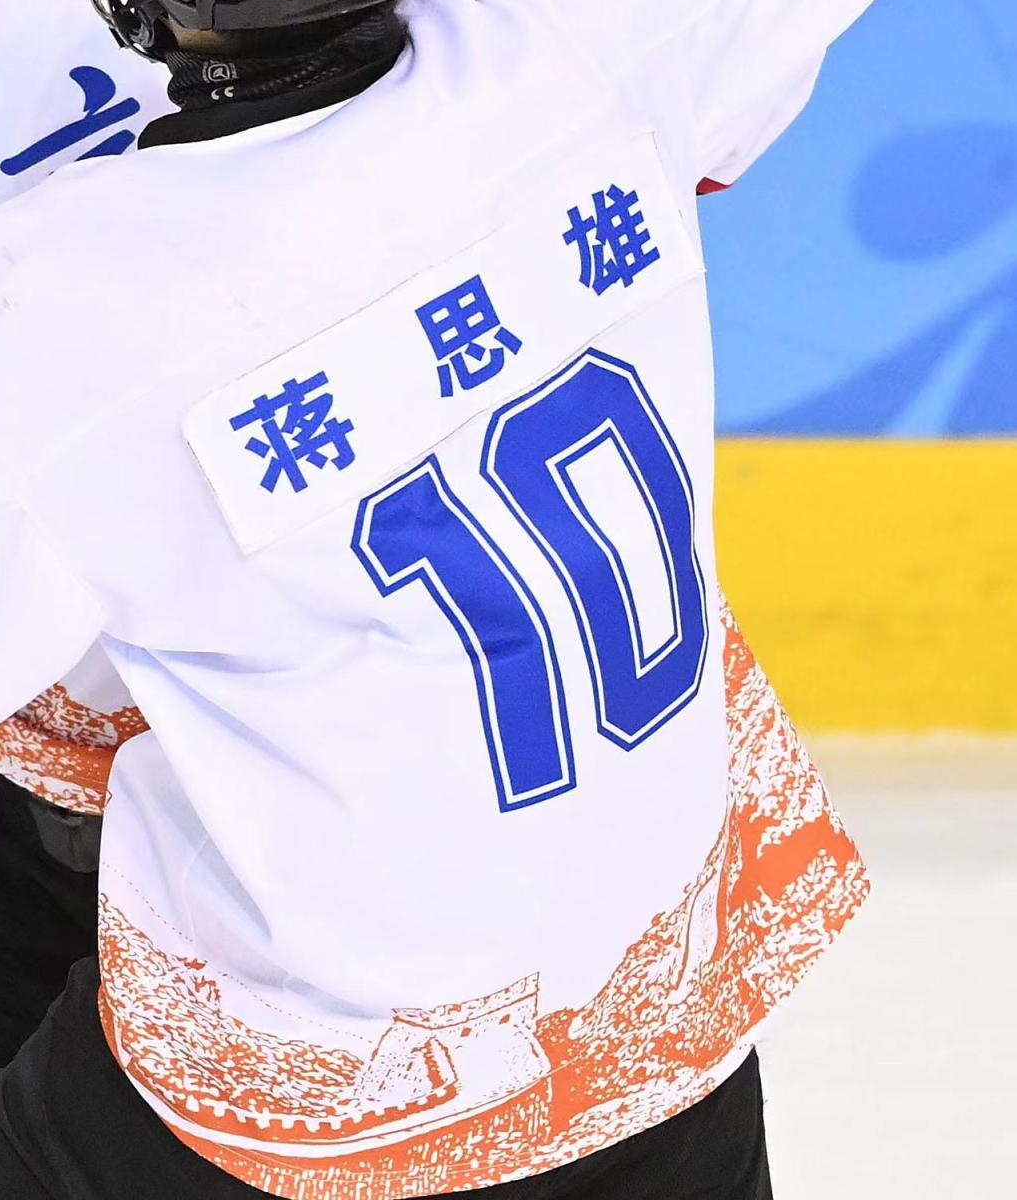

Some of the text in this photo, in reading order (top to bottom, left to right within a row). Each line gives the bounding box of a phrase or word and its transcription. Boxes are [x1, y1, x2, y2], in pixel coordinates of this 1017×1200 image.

[228, 183, 661, 494] 蒋思雄
[350, 347, 710, 814] 10
